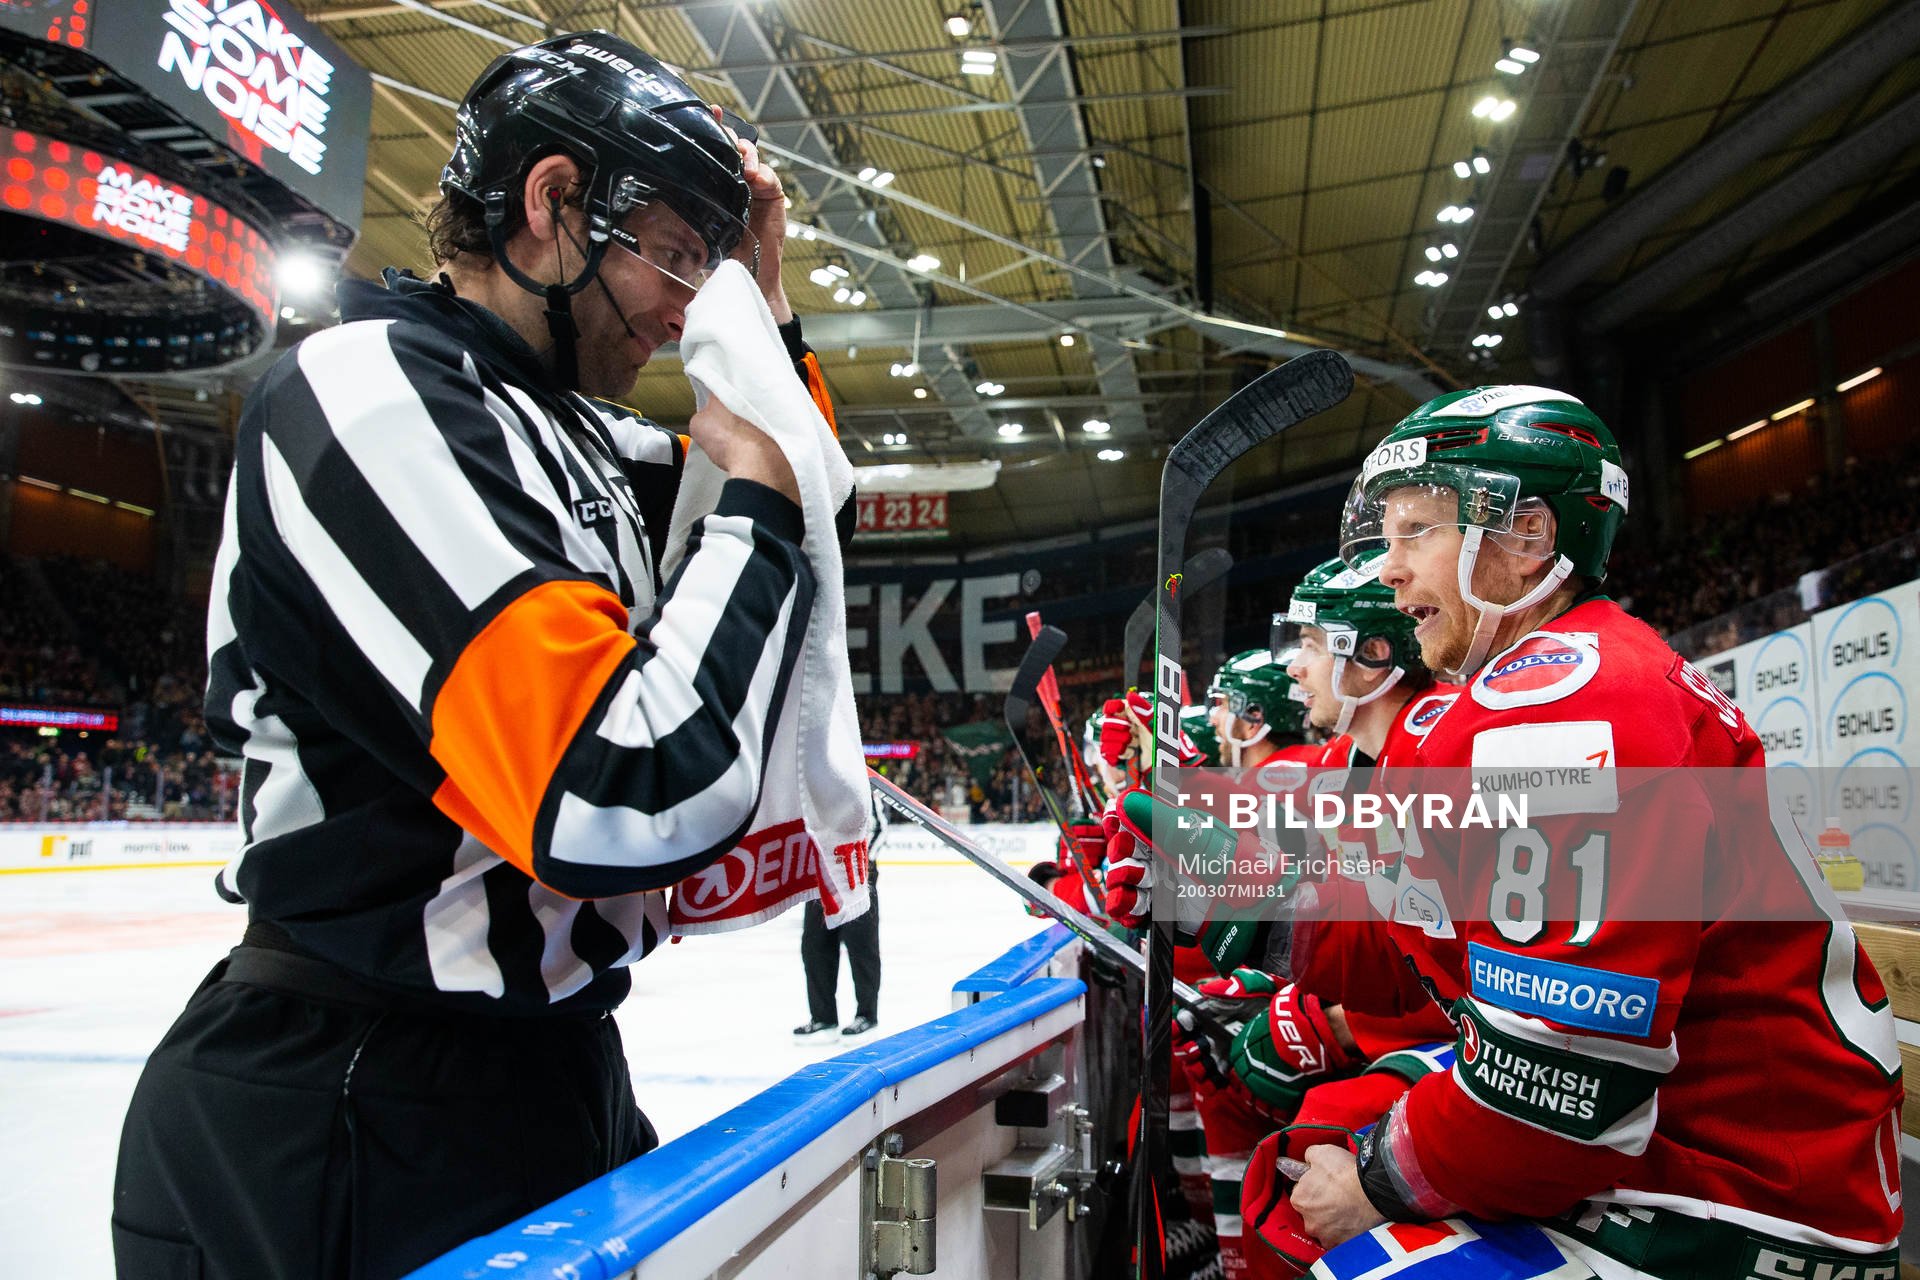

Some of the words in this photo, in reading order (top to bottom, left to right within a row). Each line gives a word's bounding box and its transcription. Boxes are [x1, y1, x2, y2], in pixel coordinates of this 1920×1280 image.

[162, 0, 331, 135] SOME
[213, 0, 335, 95] AKE
[158, 31, 327, 175] NOISE
[95, 184, 191, 235] SOME
[98, 166, 193, 216] MAKE
[93, 201, 189, 252] NOISE
[612, 228, 637, 243] CCM
[580, 500, 613, 522] CC
[884, 501, 911, 527] 23
[917, 499, 944, 525] 24
[1490, 653, 1577, 677] VOLVO
[1833, 632, 1889, 667] BOHUS
[1757, 662, 1799, 692] BOHUS
[1837, 707, 1894, 738] BOHUS
[1479, 771, 1543, 793] KUMHO
[1546, 768, 1591, 787] TYRE
[1842, 785, 1900, 810] BOHUS
[1489, 825, 1608, 944] 81
[1475, 959, 1647, 1020] EHRENBORG
[1275, 984, 1318, 1068] UER
[1475, 1062, 1596, 1120] AIRLINES
[1482, 1039, 1600, 1098] TURKISH
